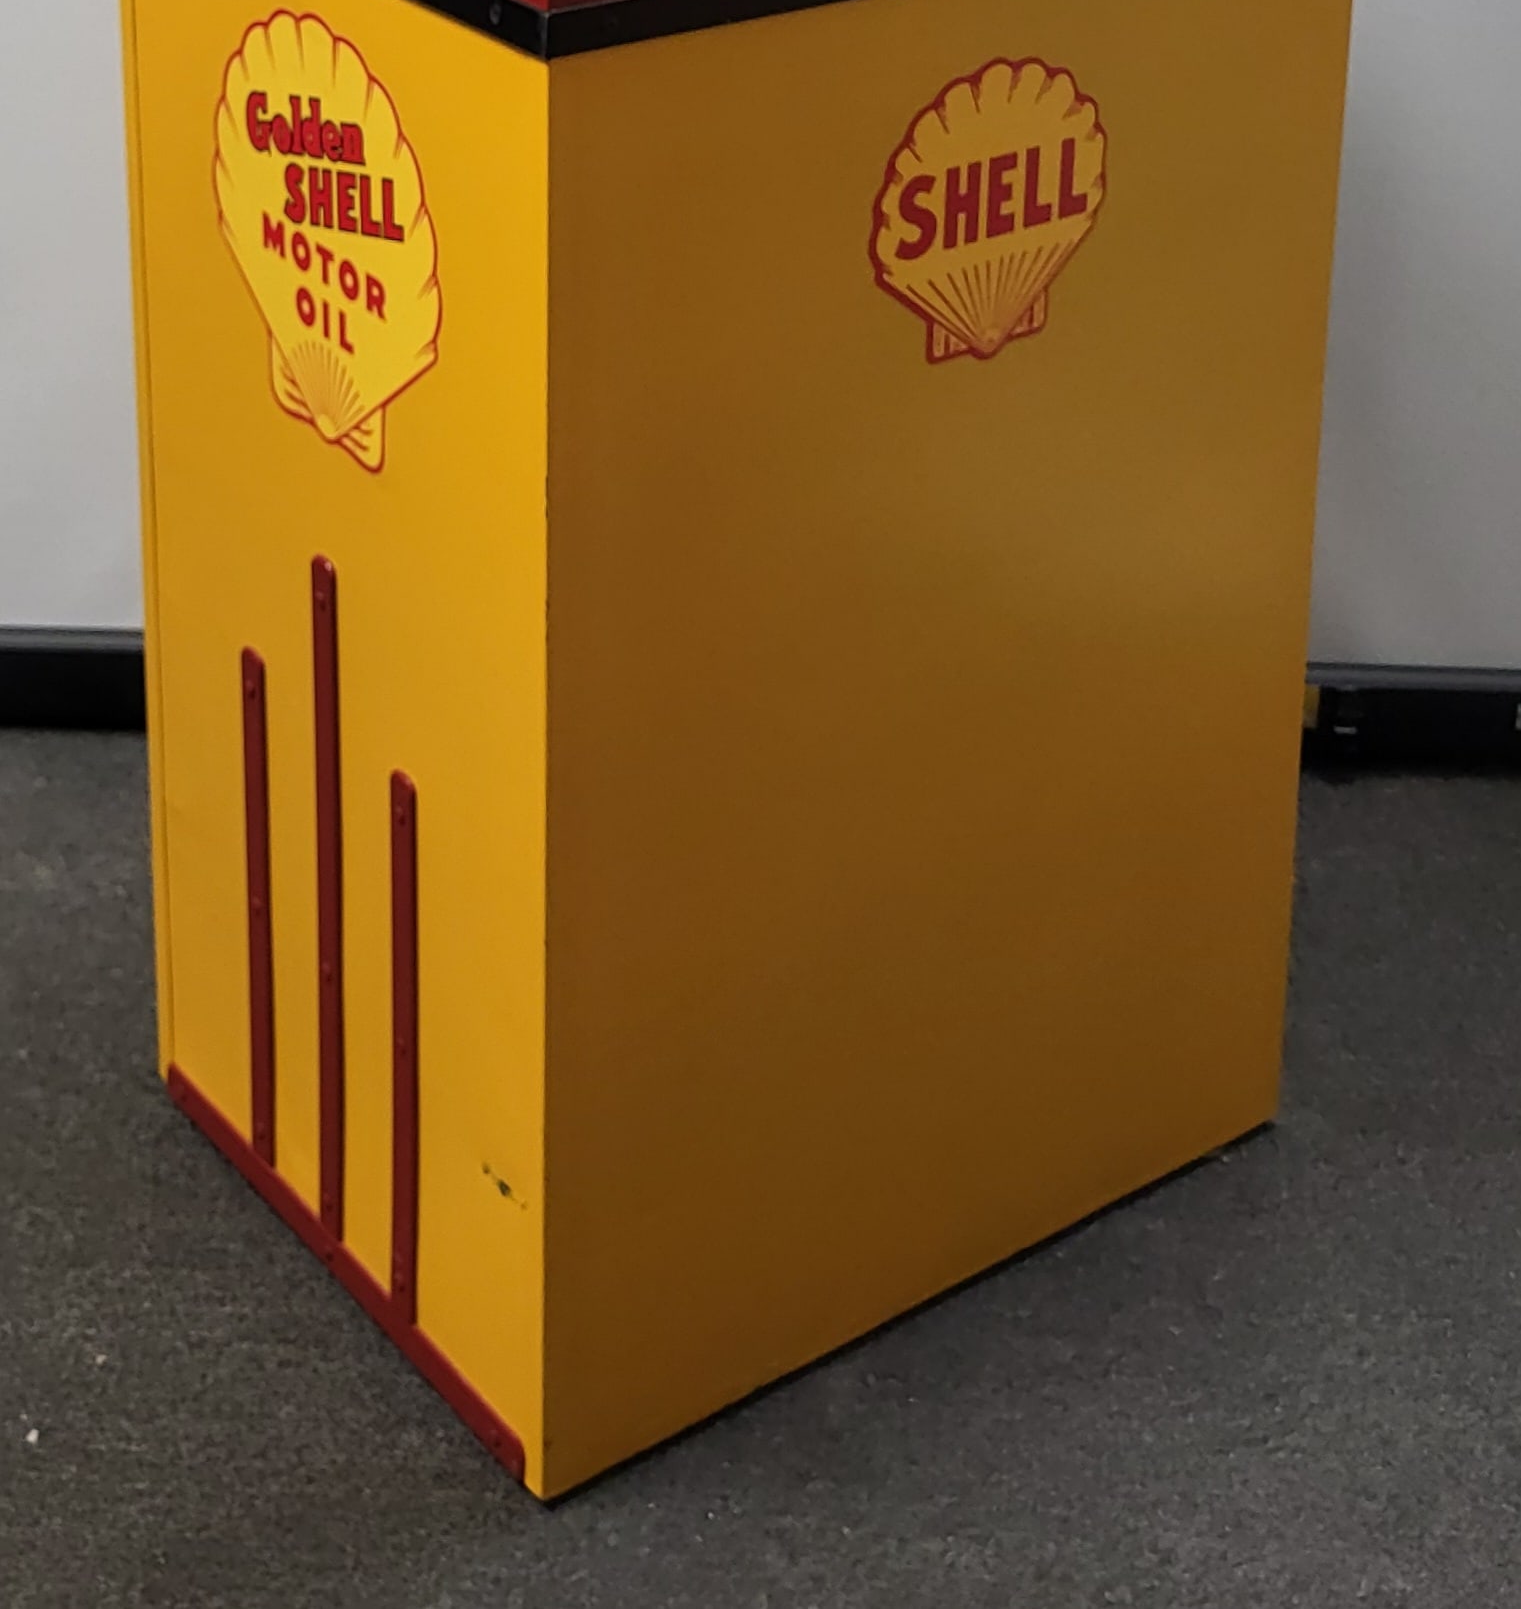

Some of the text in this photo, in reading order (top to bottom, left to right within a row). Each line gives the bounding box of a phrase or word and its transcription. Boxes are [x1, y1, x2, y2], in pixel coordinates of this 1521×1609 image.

[246, 90, 365, 164] Golden
[284, 162, 404, 242] SHELL
[896, 137, 1088, 261] SHELL
[262, 212, 387, 321] MOTOR
[296, 287, 355, 355] OIL
